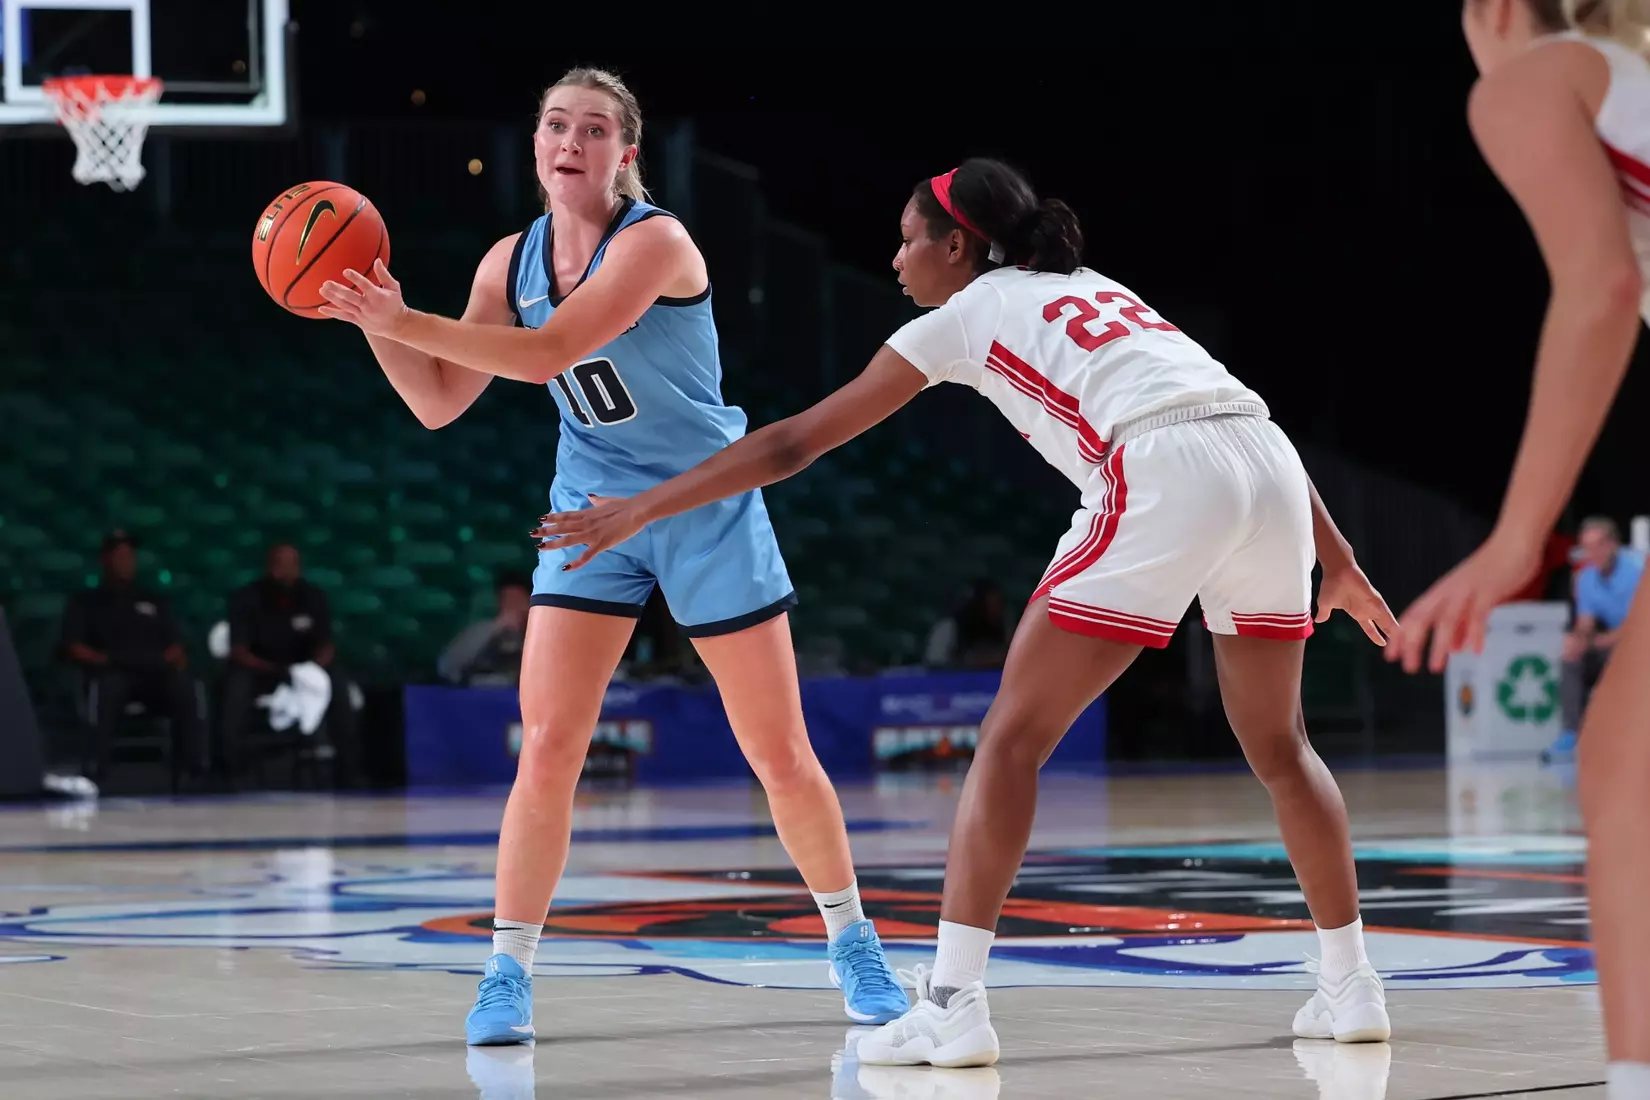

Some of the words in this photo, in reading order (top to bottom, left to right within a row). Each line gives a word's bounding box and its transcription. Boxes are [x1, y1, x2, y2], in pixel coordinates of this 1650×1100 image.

[258, 184, 311, 243] ELITE
[1042, 291, 1181, 353] 22
[552, 357, 638, 428] 10
